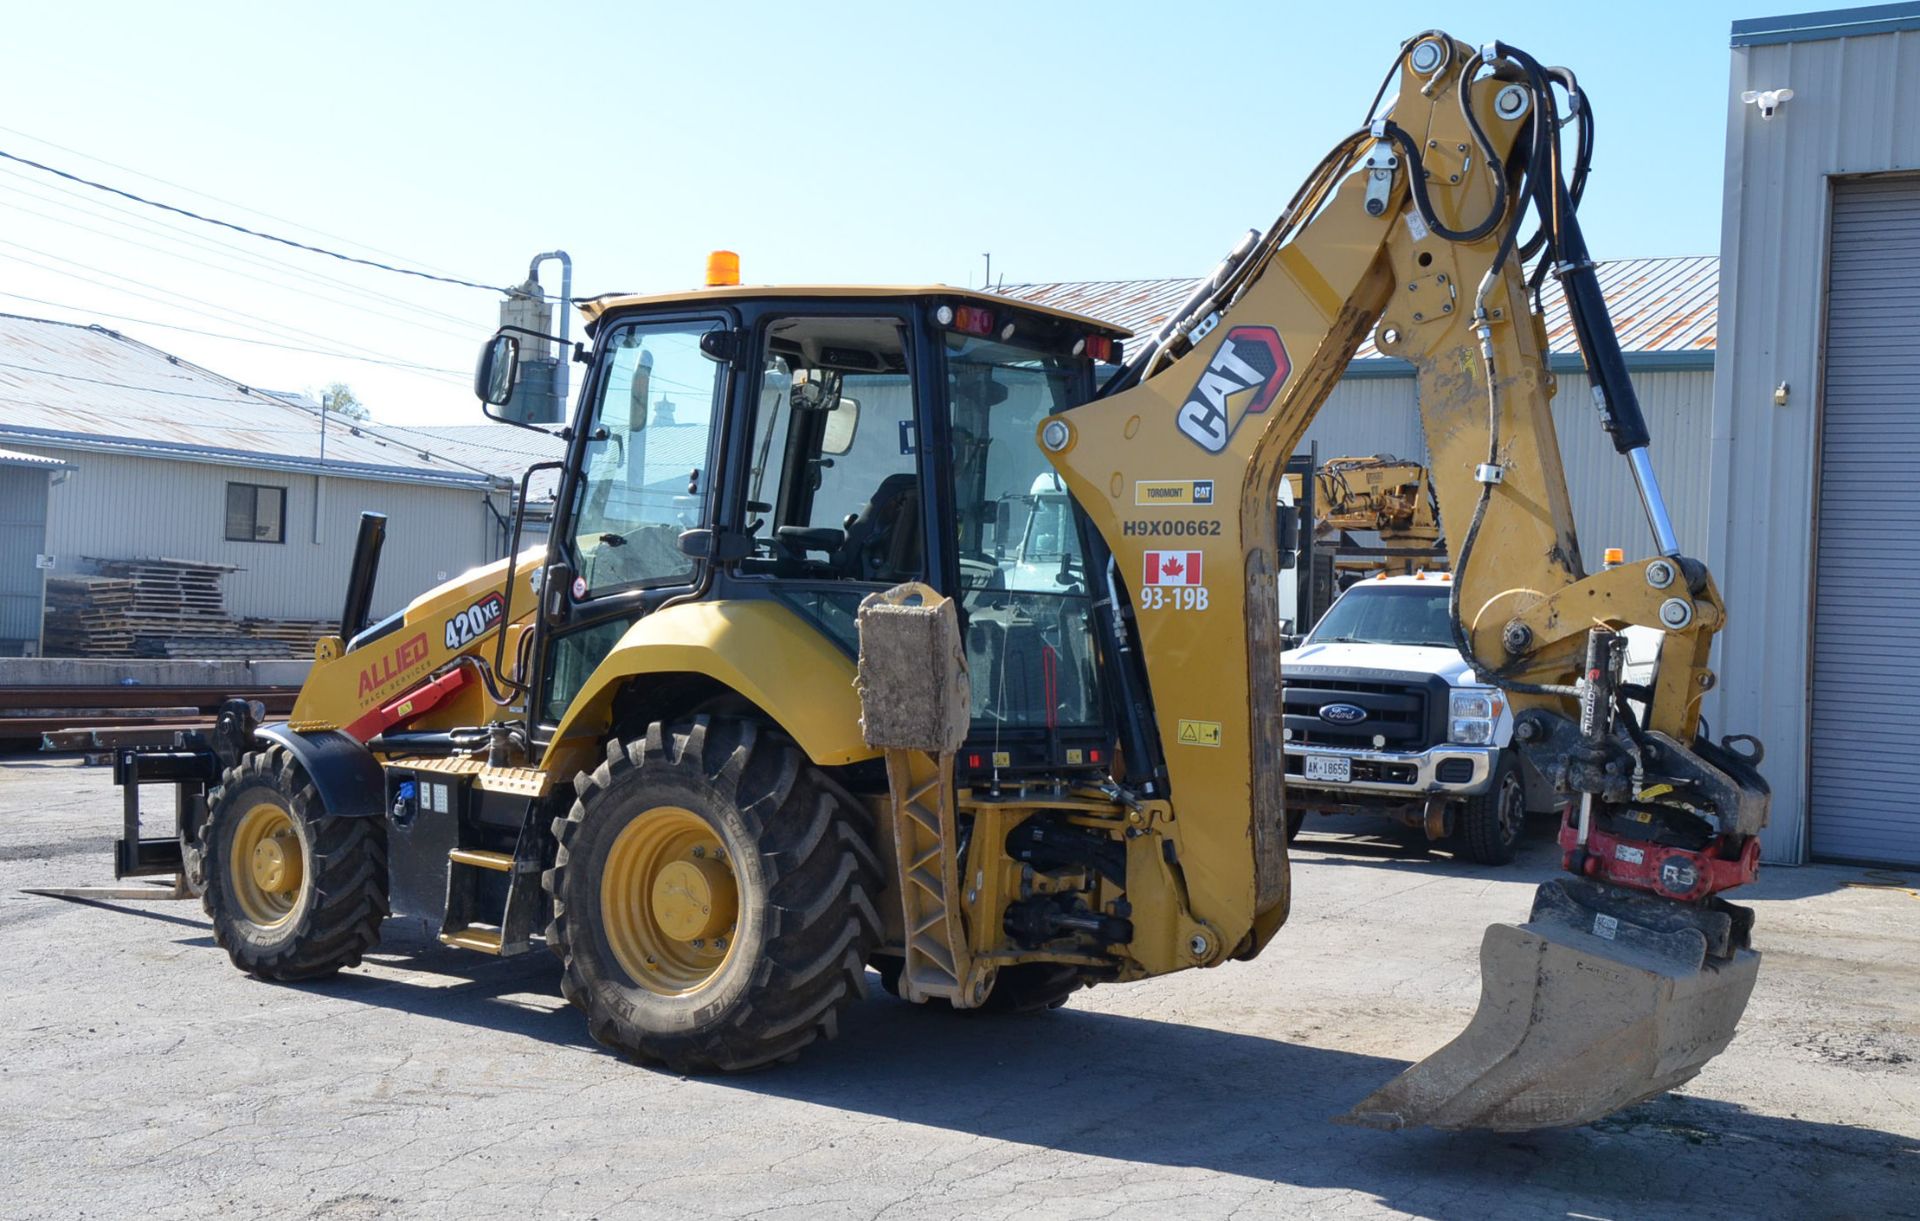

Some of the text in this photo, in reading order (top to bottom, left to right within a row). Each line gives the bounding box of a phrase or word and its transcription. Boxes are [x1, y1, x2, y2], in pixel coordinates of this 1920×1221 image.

[1177, 338, 1266, 453] CAT
[1147, 487, 1211, 499] TOROMONT CAT
[1123, 520, 1221, 536] H9X00662
[1140, 587, 1209, 611] 93-19B
[358, 632, 429, 699] ALLIED
[359, 660, 432, 709] TRACK SERVICES
[1329, 706, 1355, 720] Ford
[1663, 864, 1695, 886] R3
